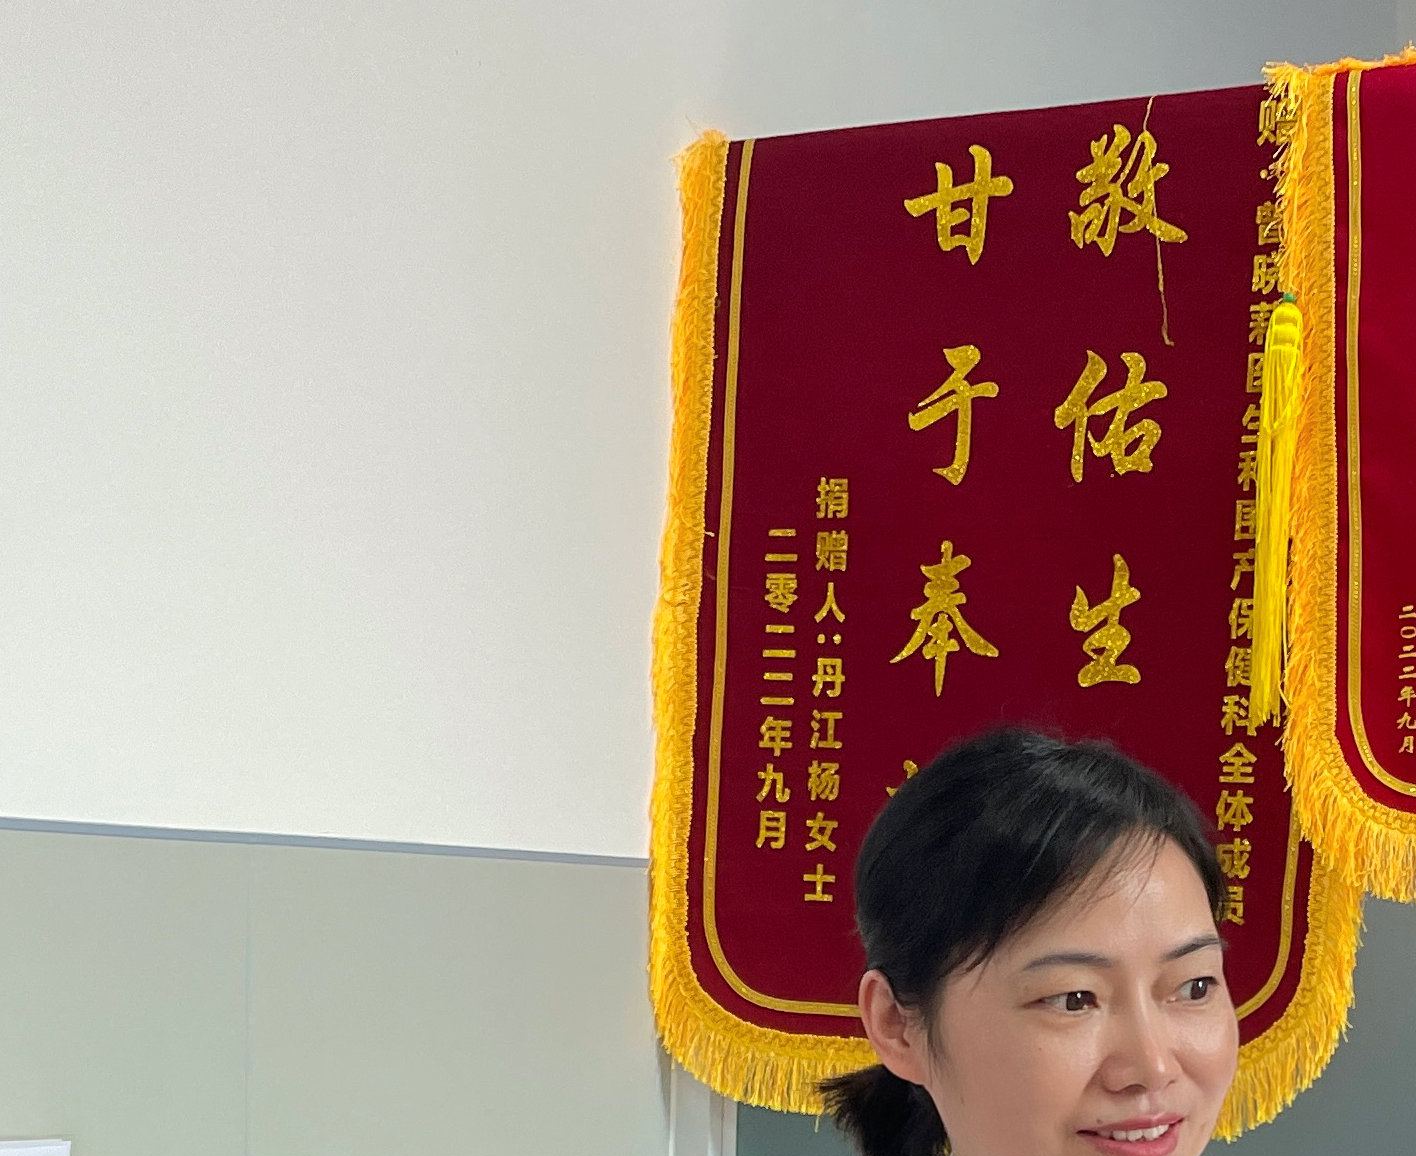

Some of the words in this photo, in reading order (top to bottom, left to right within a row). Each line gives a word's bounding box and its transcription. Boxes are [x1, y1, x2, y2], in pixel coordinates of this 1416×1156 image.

[886, 145, 1013, 798] 甘于奉
[755, 528, 798, 849] 二零二二年九月
[802, 476, 849, 903] 捐赠人：丹江杨女士
